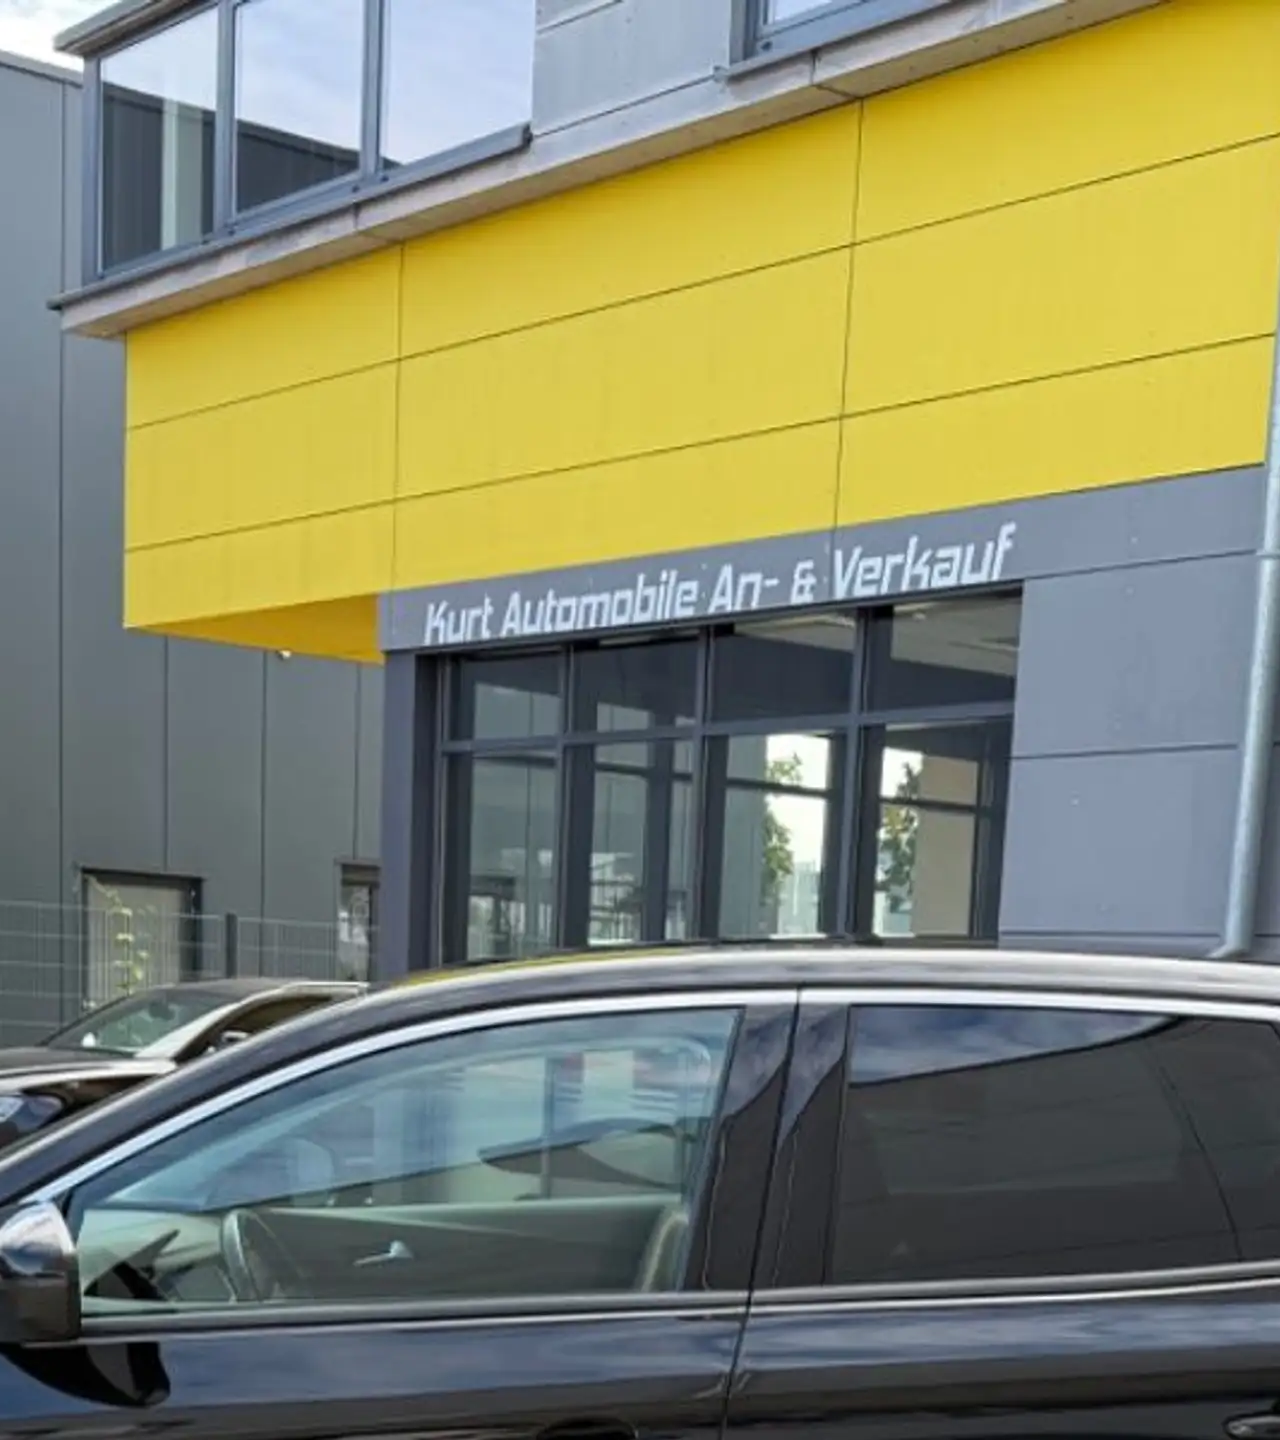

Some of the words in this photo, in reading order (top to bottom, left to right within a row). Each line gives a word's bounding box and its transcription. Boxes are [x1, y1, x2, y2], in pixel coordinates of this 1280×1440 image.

[423, 597, 494, 646] Kurt
[501, 567, 699, 638] Automobile
[708, 563, 779, 614] An-
[790, 559, 817, 605] &
[833, 522, 1017, 600] Verkauf
